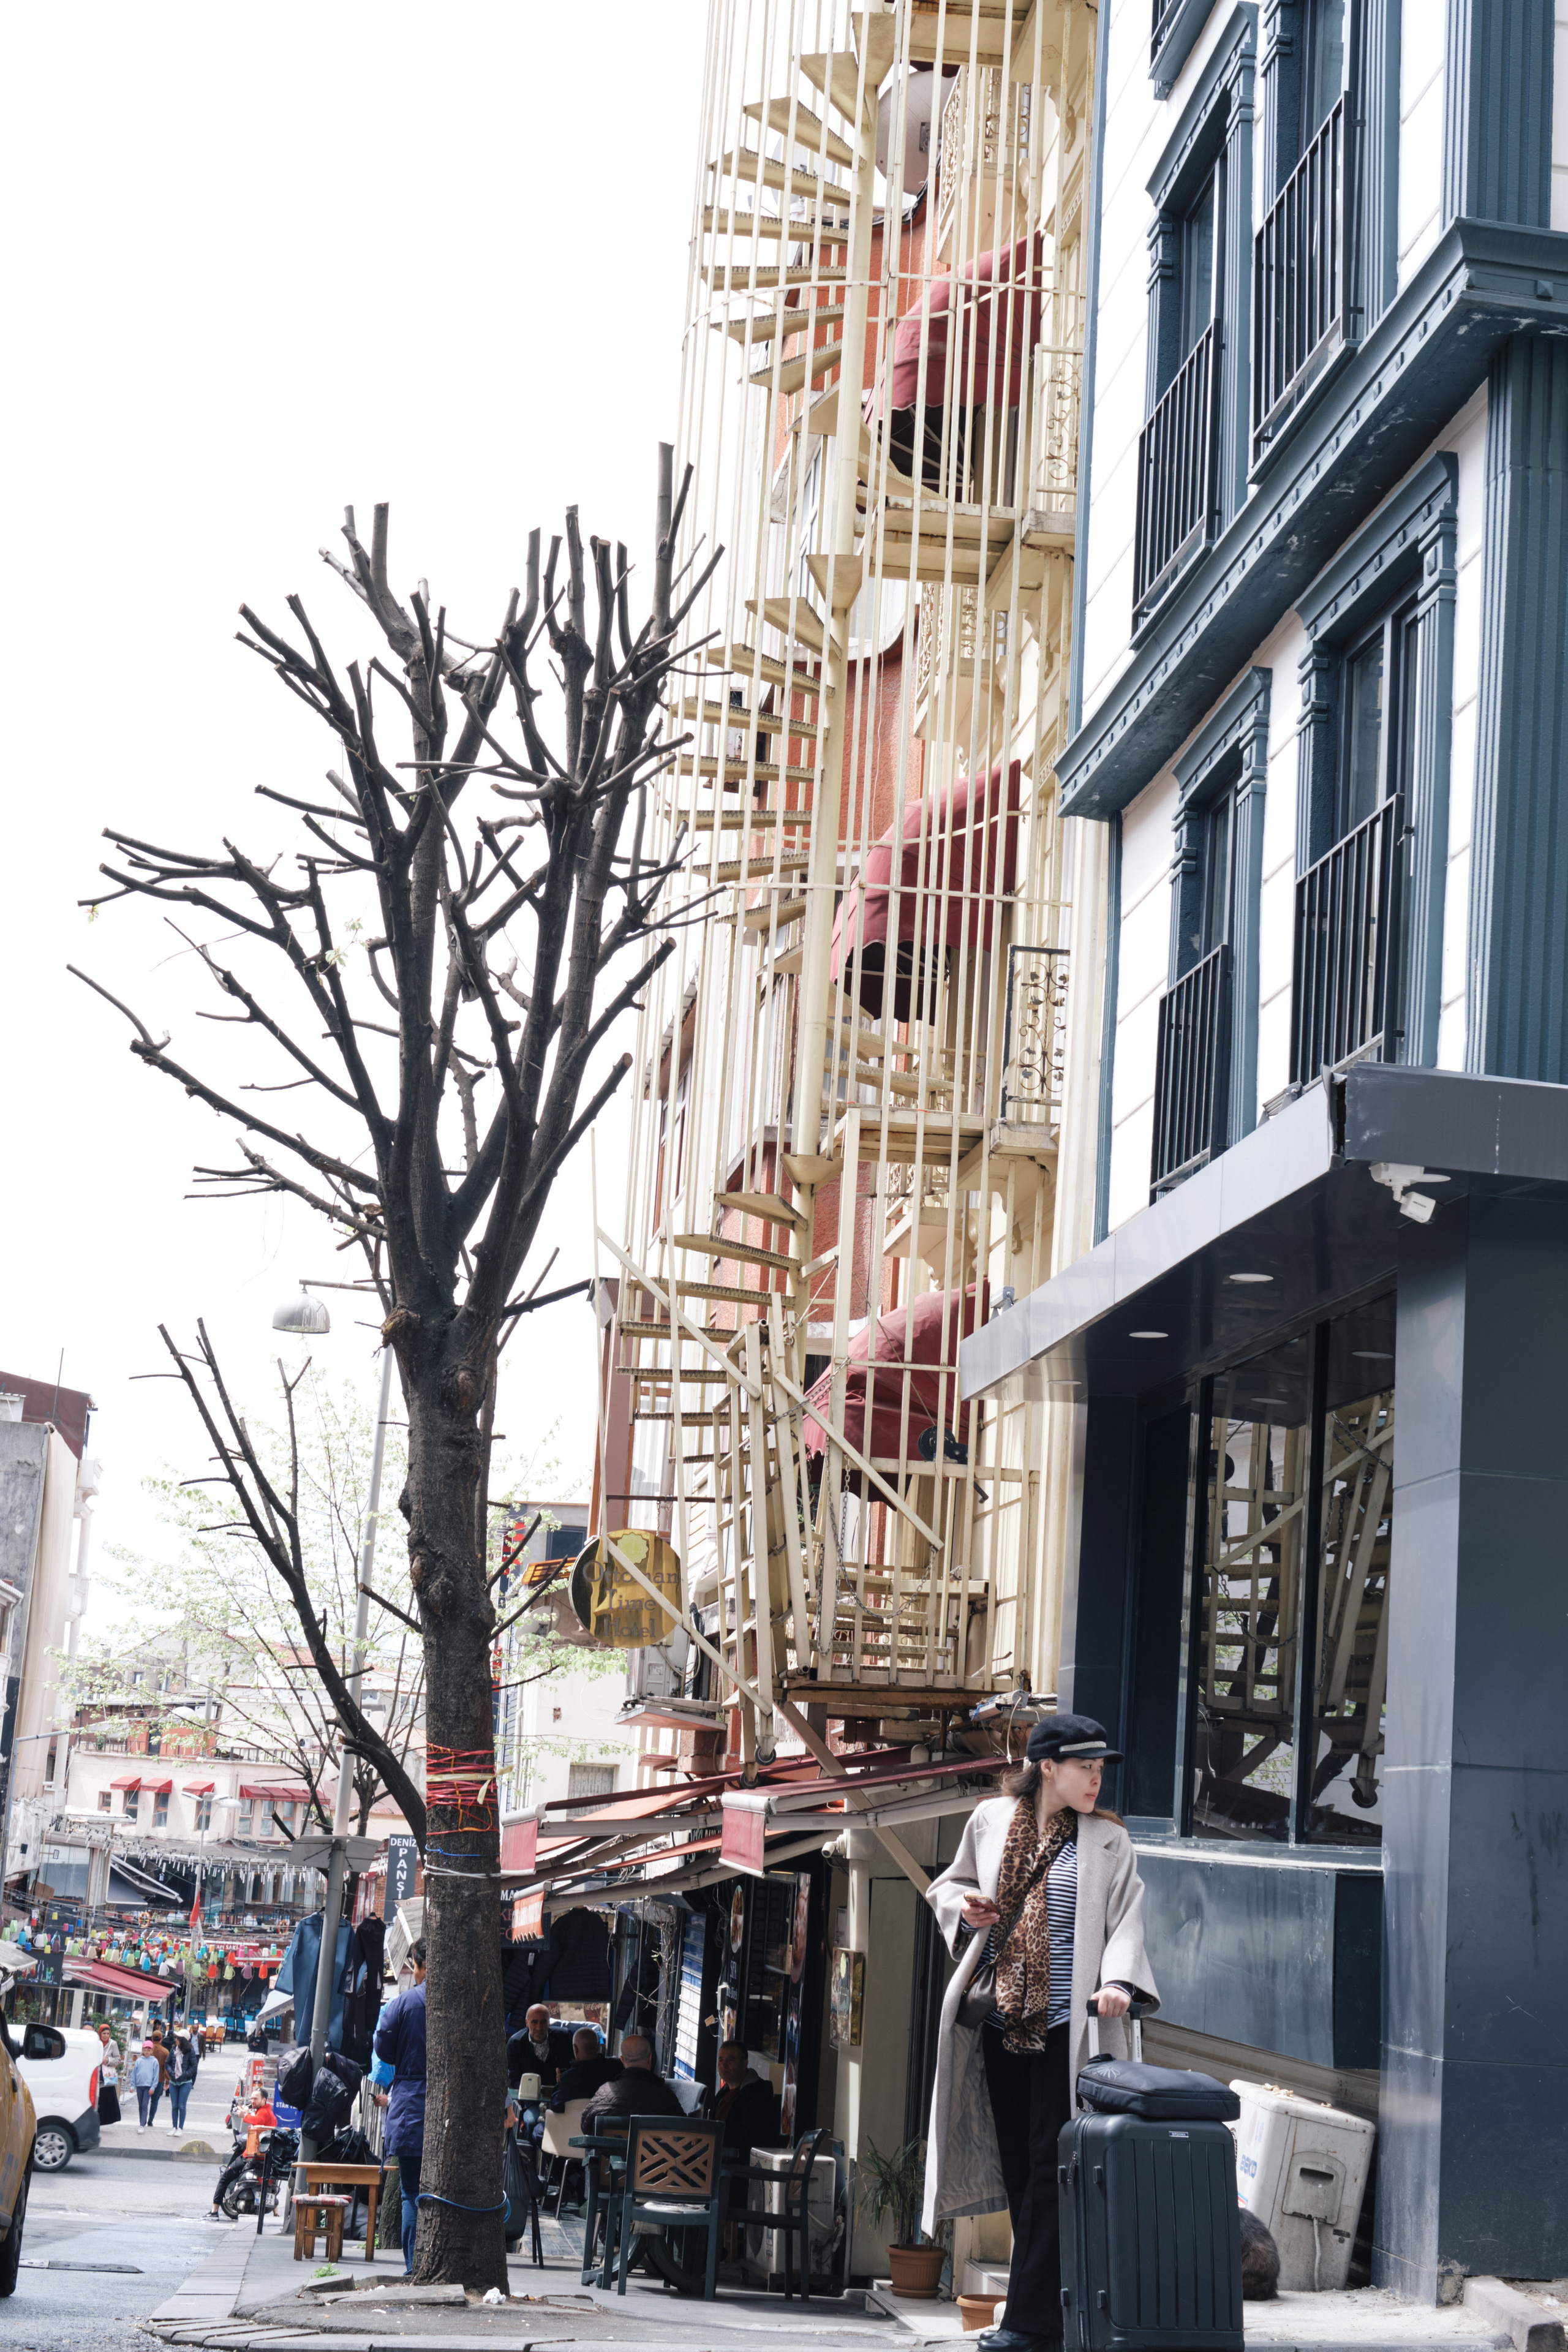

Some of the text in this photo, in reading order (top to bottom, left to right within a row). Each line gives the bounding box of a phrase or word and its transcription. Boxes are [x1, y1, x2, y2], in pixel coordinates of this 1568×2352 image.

[605, 1588, 657, 1611] Time
[604, 1617, 656, 1637] Hotel
[390, 1836, 417, 1847] DENİZ
[396, 1847, 408, 1900] PANSİ
[1240, 2154, 1257, 2179] BEKO
